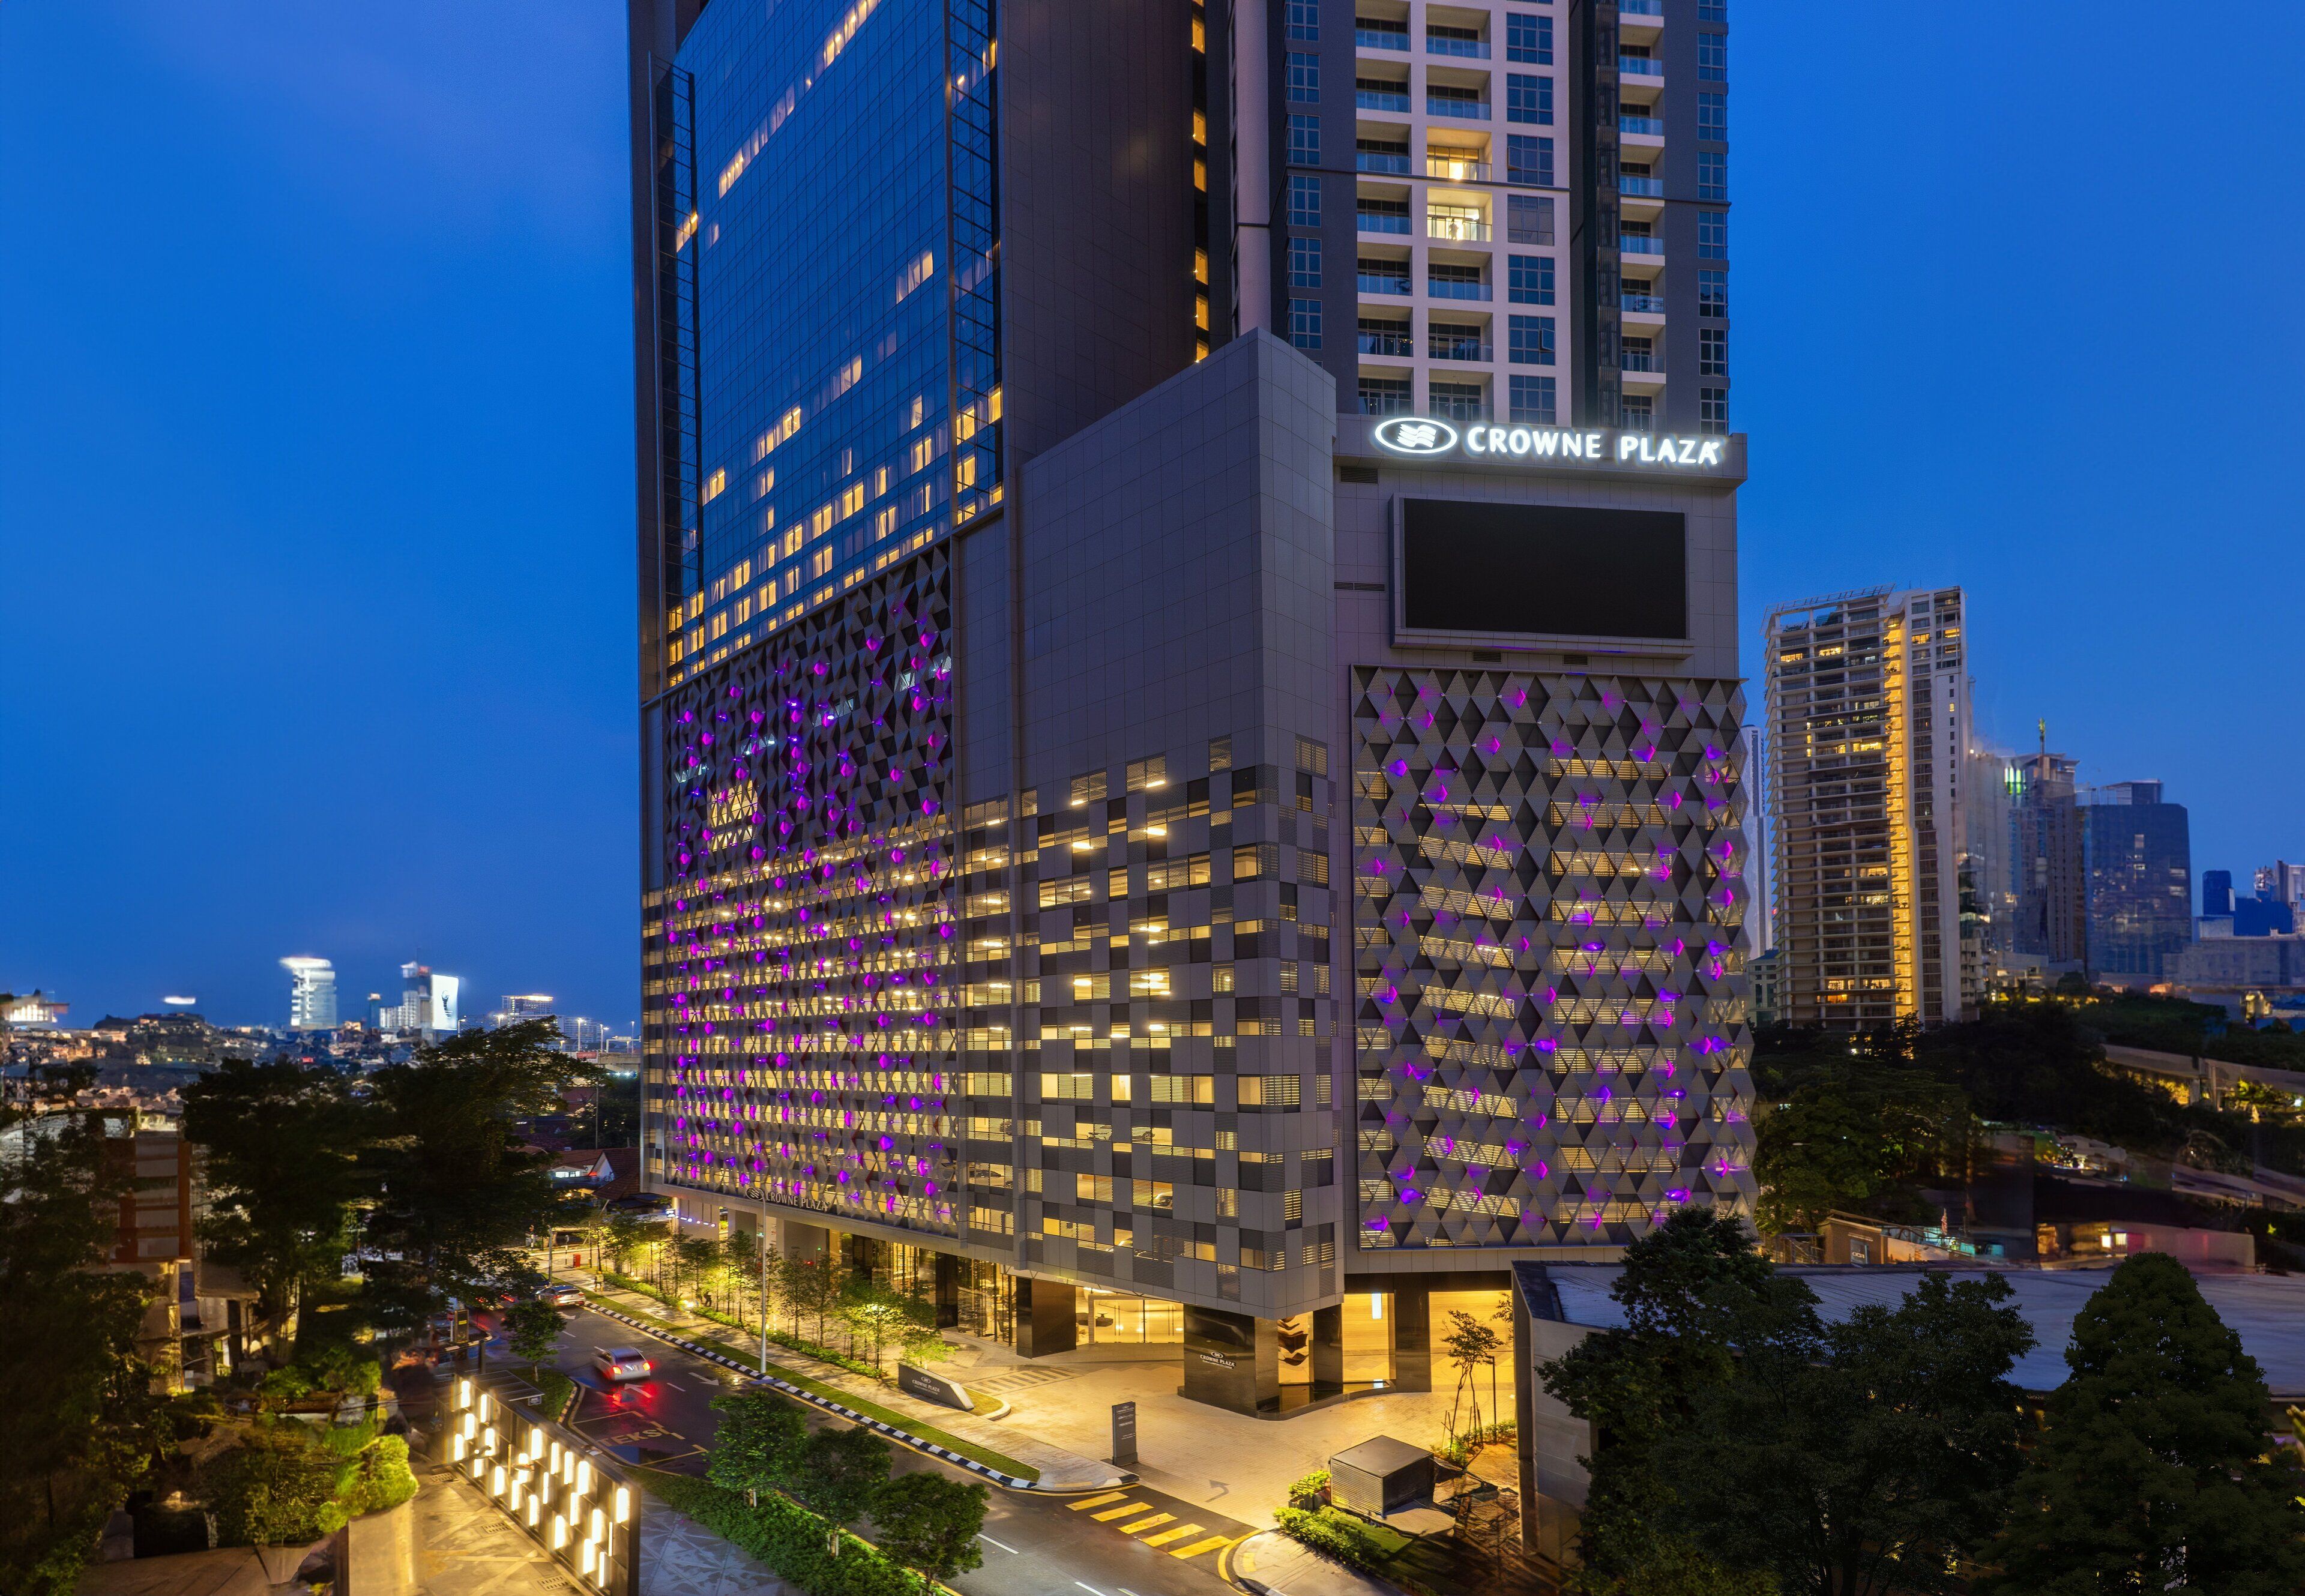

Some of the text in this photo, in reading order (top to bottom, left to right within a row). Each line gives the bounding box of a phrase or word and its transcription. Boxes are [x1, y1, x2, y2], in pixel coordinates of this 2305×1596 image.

[1467, 427, 1719, 465] CROWNE PLAZA
[766, 1192, 828, 1211] CROWNE PLAZA
[1200, 1354, 1219, 1363] CROWNE
